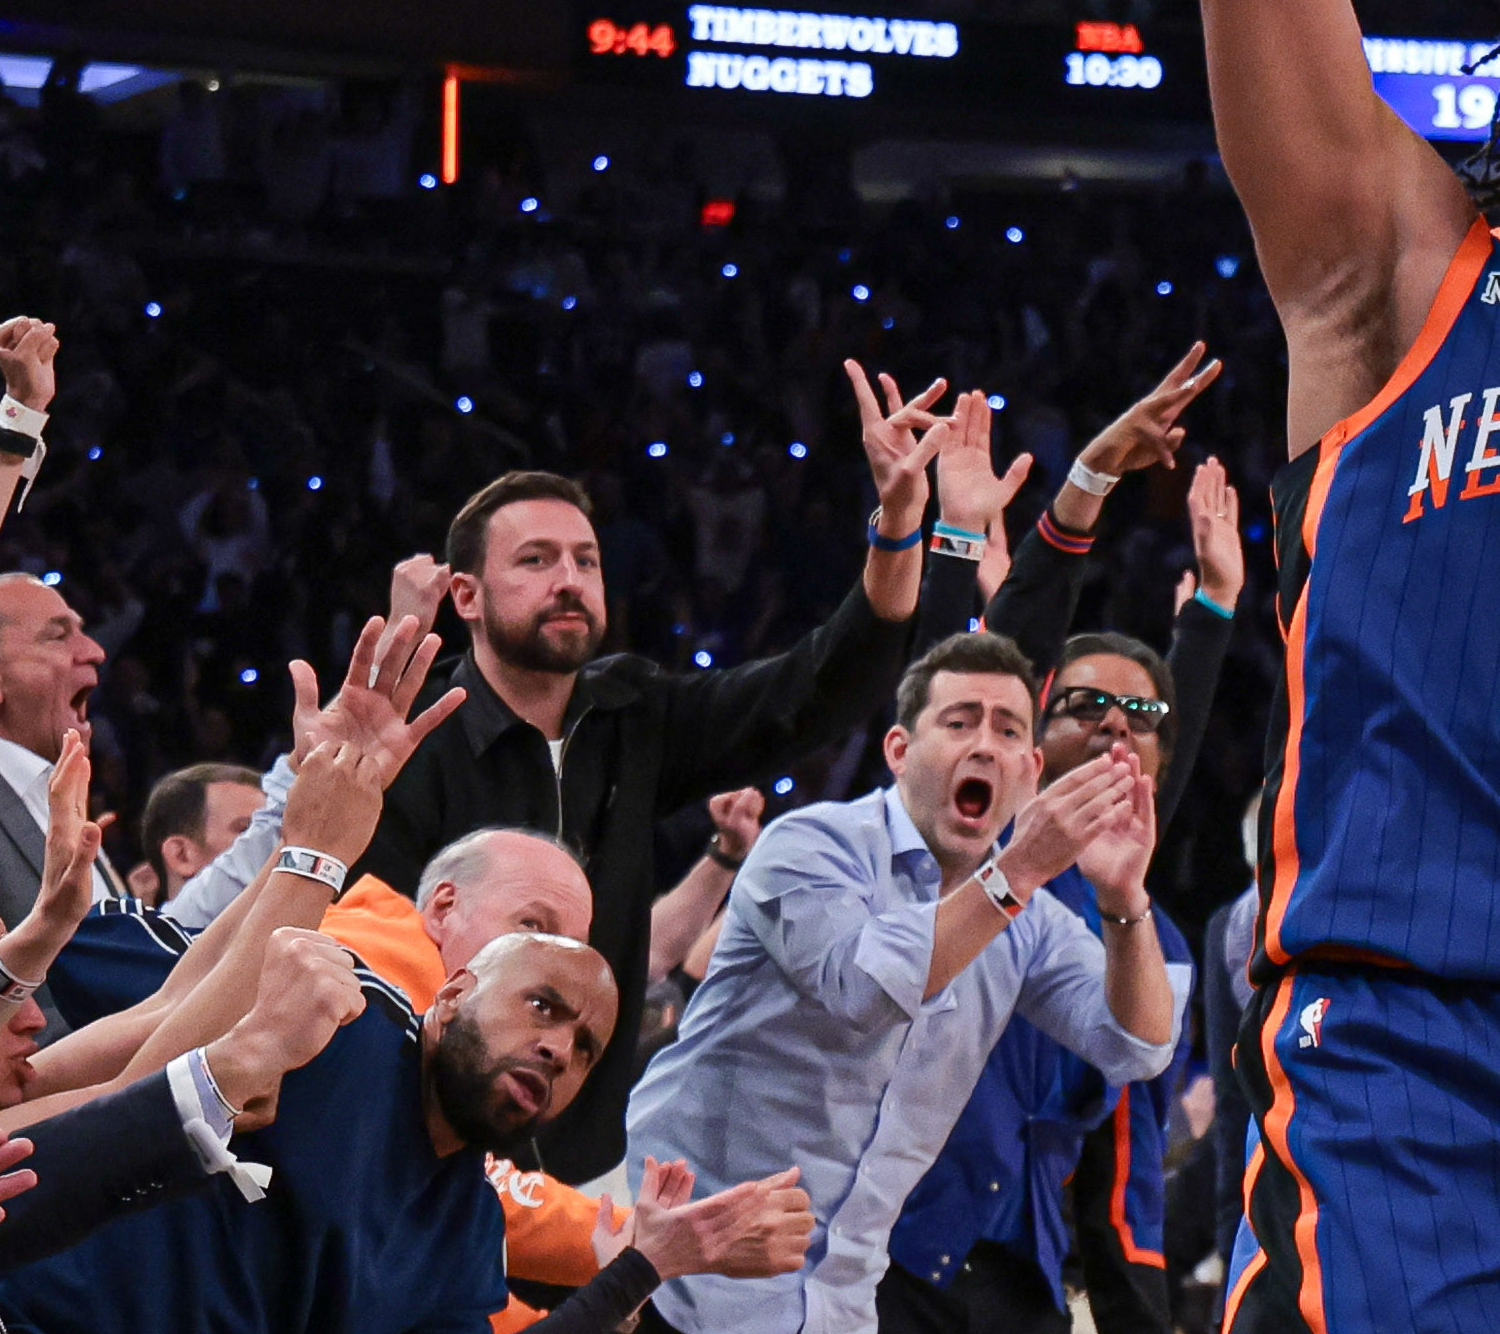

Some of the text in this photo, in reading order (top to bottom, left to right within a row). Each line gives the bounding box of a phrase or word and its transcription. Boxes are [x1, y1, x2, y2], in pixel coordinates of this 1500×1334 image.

[588, 17, 676, 57] 9:44
[688, 4, 960, 58] TIMBERWOLVES
[1075, 20, 1145, 54] NBA
[685, 52, 875, 99] NUGGETS
[1064, 53, 1164, 89] 10:30
[1432, 83, 1497, 129] 19
